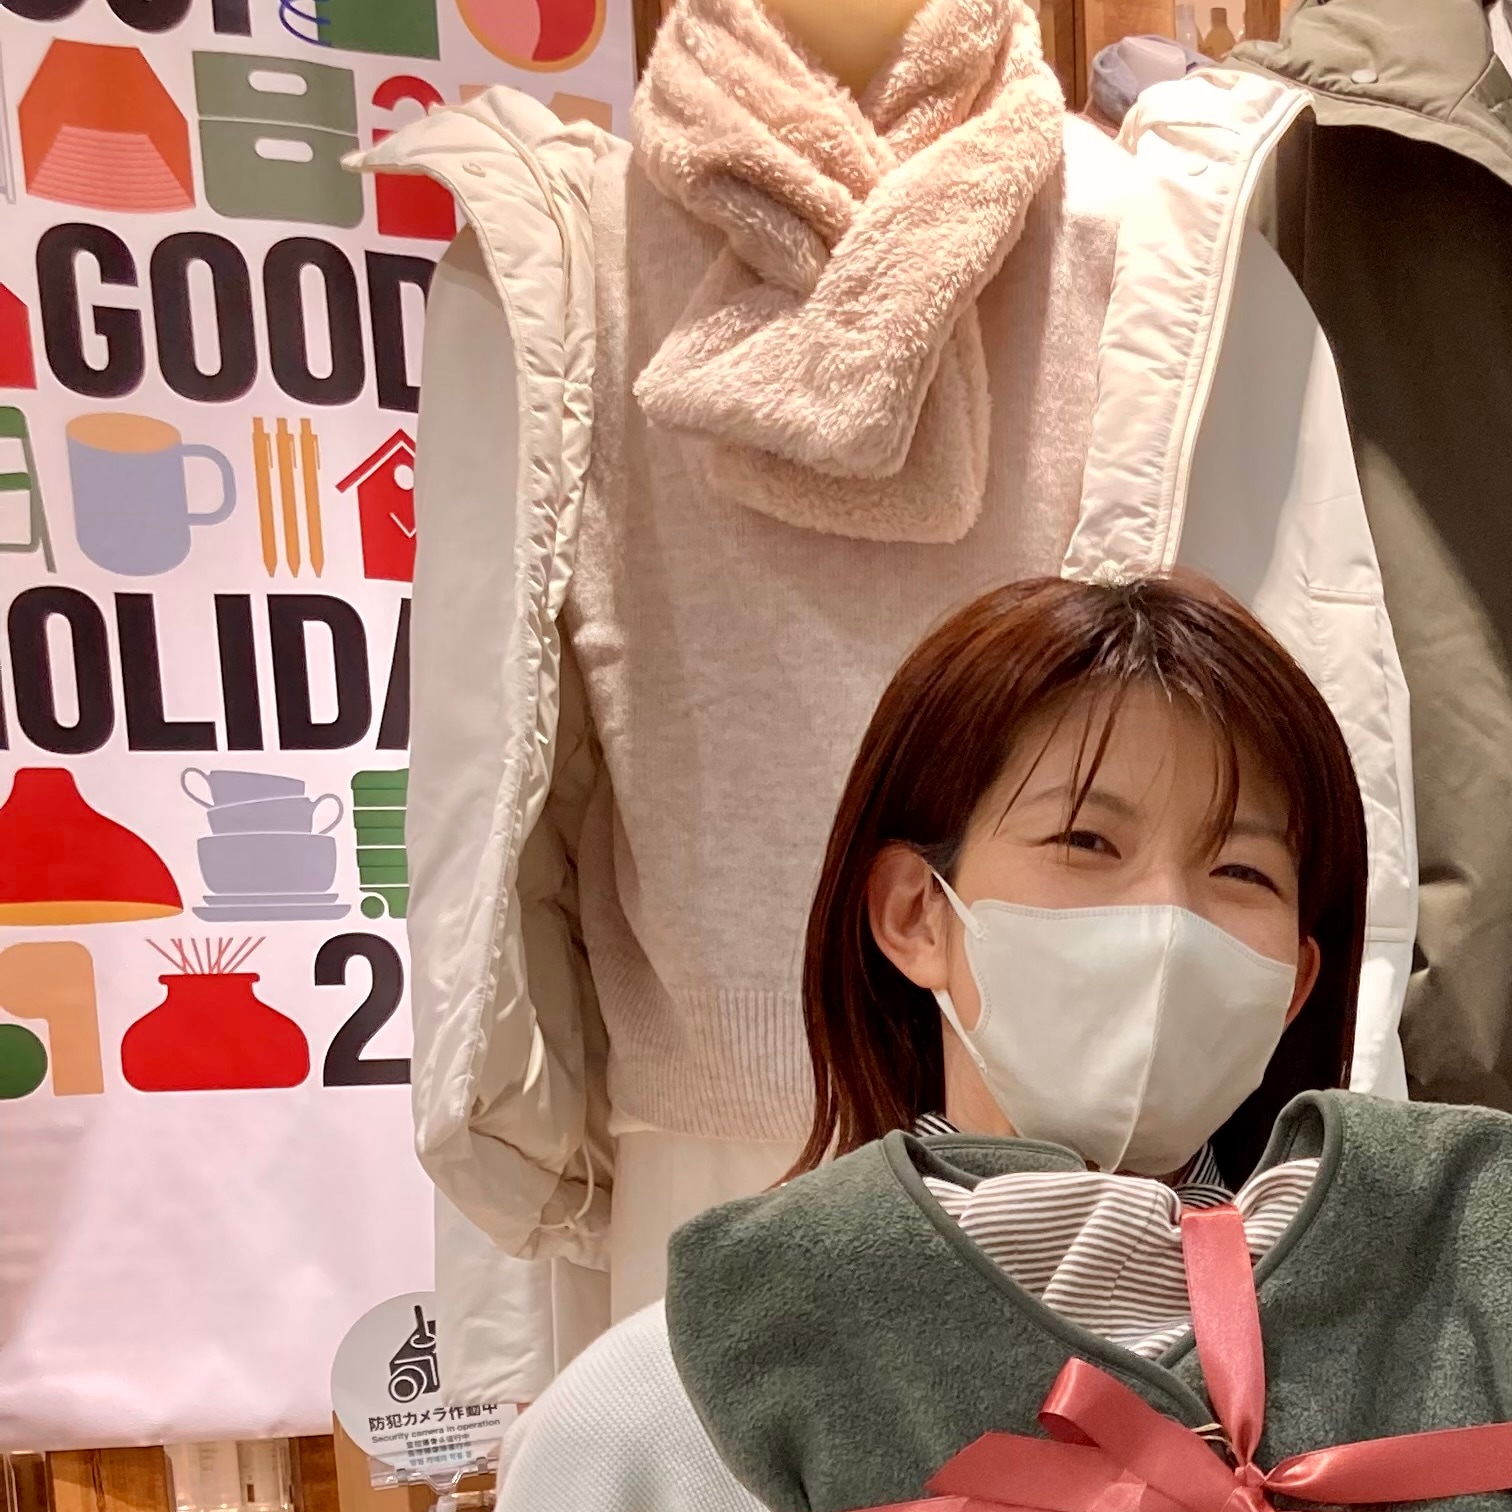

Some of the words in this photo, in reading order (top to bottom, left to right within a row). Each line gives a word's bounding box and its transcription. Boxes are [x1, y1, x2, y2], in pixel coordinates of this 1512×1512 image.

[0, 586, 411, 754] OLID
[368, 1403, 498, 1432] 防犯カメラ作動中
[371, 1432, 409, 1443] Security
[411, 1428, 445, 1438] camera
[446, 1425, 456, 1433] in
[457, 1418, 501, 1432] operation
